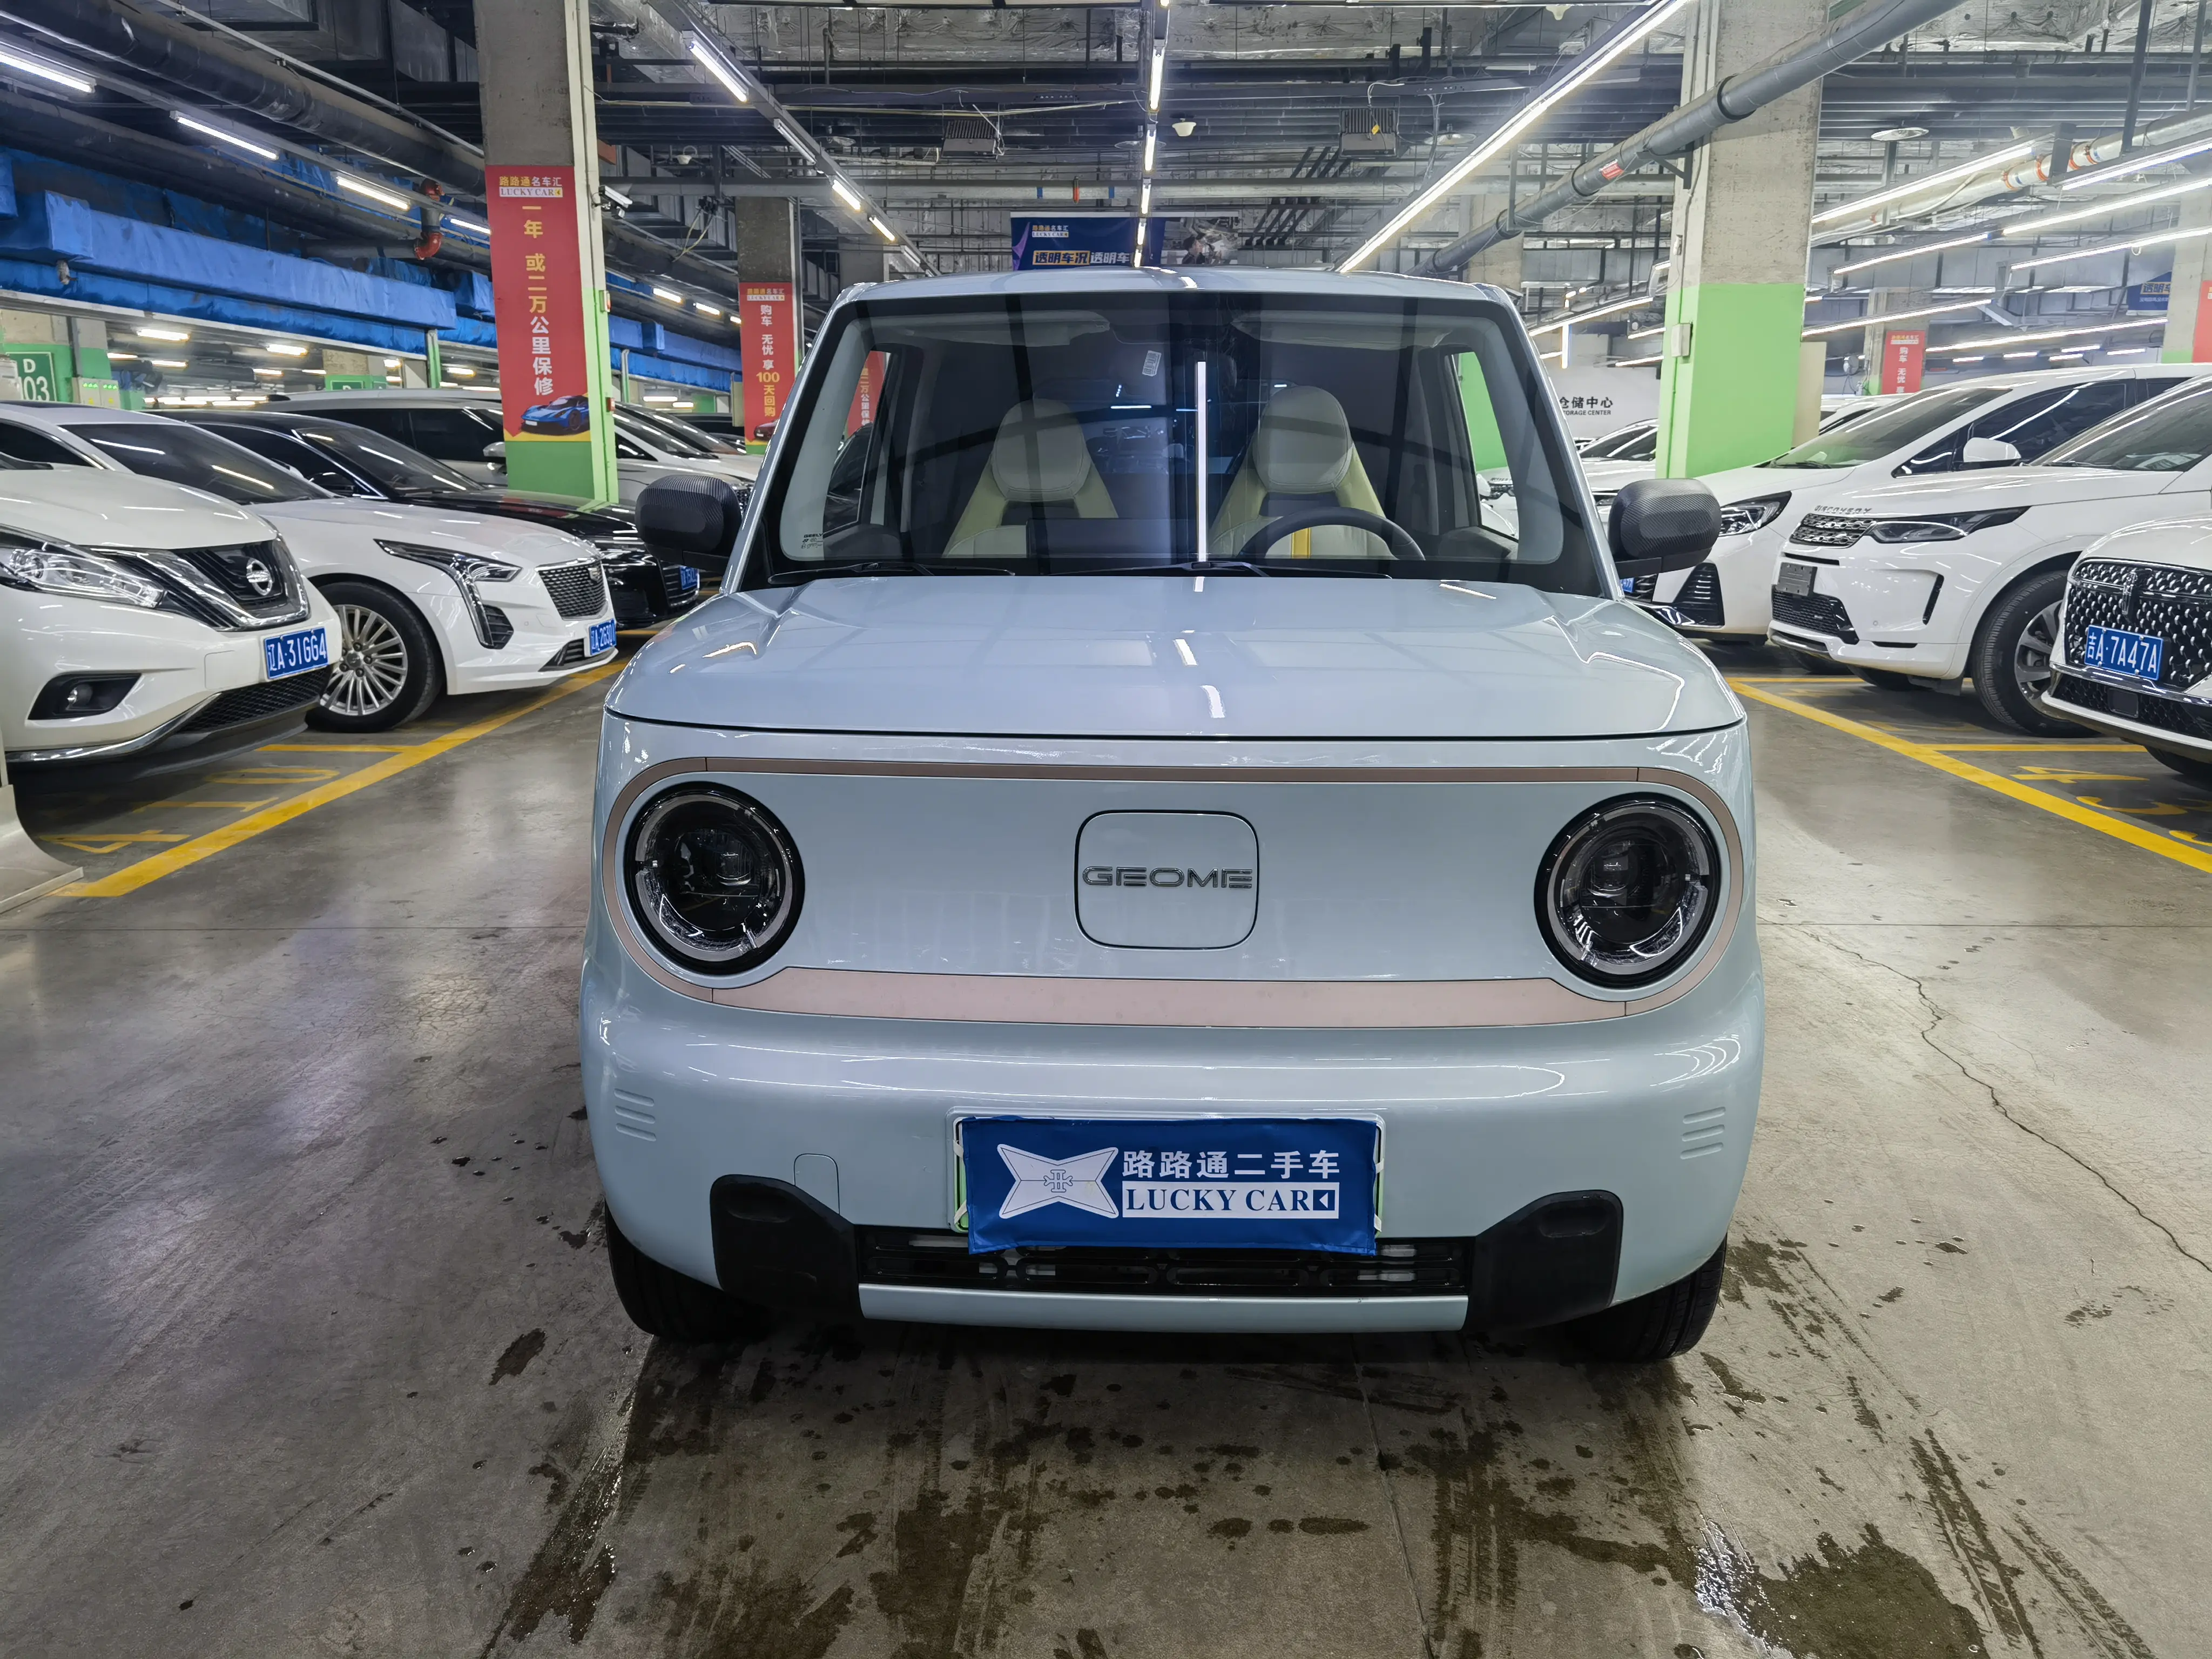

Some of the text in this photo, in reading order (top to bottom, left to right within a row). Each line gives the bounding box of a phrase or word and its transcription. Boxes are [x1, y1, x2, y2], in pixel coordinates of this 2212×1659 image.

[499, 176, 562, 186] 路路通名车汇
[760, 305, 772, 326] 购车
[23, 359, 36, 373] D
[1559, 396, 1613, 409] 仓储中心
[1082, 866, 1252, 889] GEOME
[1122, 1150, 1340, 1179] 路路通二手车
[1126, 1189, 1310, 1211] LUCKY CAR
